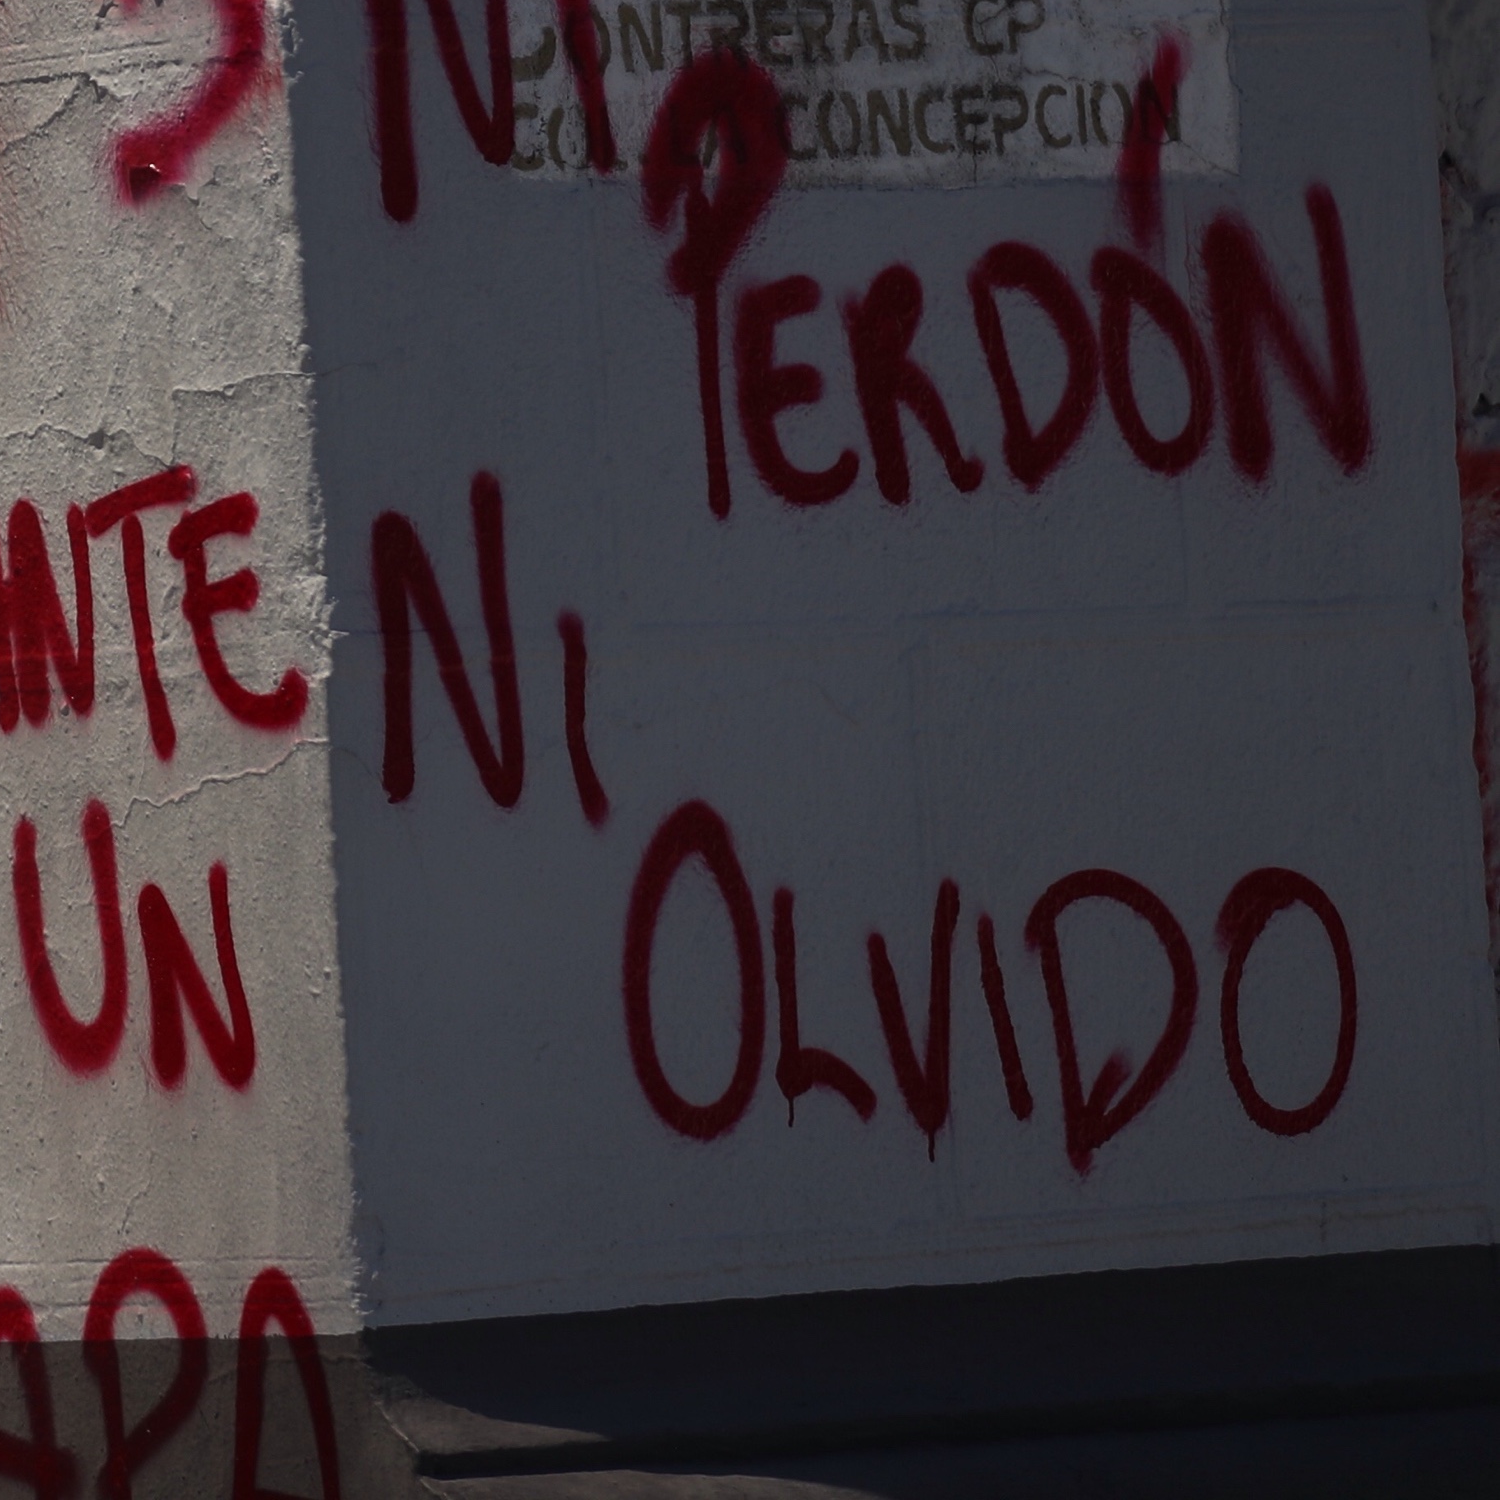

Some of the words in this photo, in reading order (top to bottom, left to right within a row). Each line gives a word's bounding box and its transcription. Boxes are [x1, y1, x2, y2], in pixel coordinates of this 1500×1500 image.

[372, 470, 607, 828] NI
[13, 798, 256, 1090] UN
[622, 798, 1358, 1178] OLVIDO
